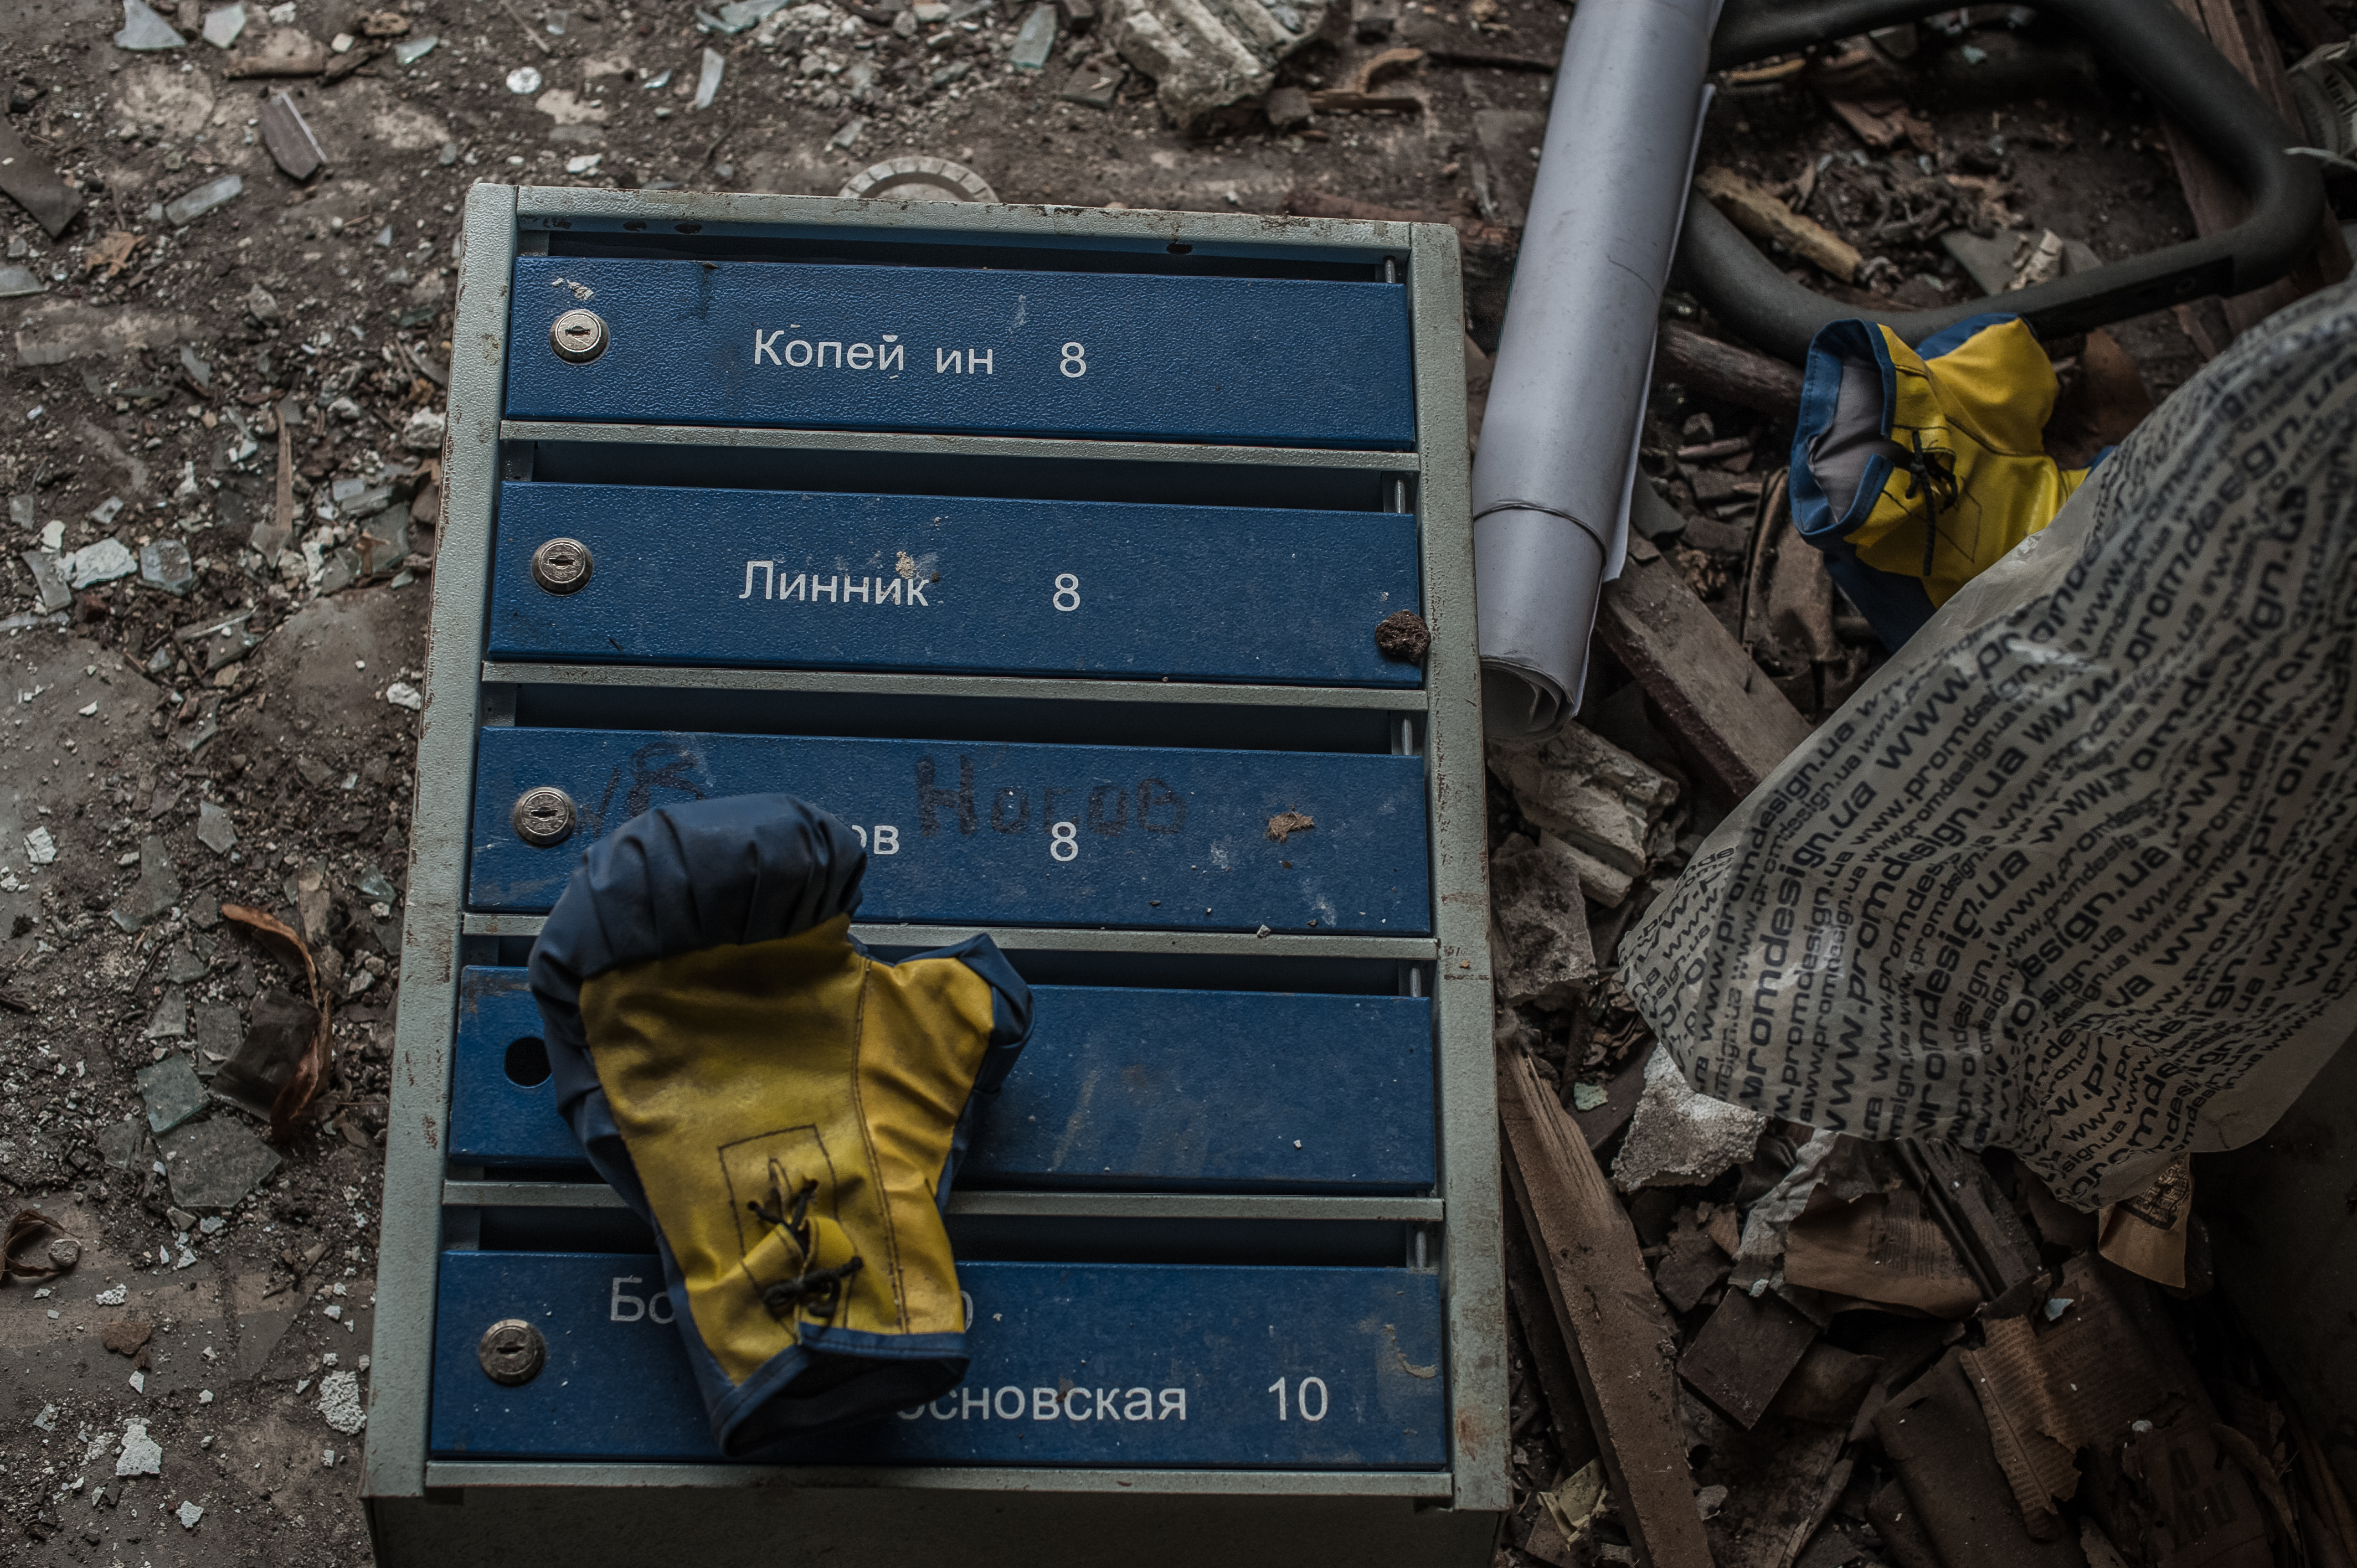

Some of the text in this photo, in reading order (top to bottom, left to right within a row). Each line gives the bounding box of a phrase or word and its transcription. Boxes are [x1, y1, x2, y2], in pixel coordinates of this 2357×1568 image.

[754, 329, 1087, 378] Копей ин 8
[739, 560, 1081, 612] Линник 8
[1050, 821, 1079, 862] 8
[1700, 721, 1854, 1042] www.promdesign.ua
[1268, 1375, 1329, 1422] 10
